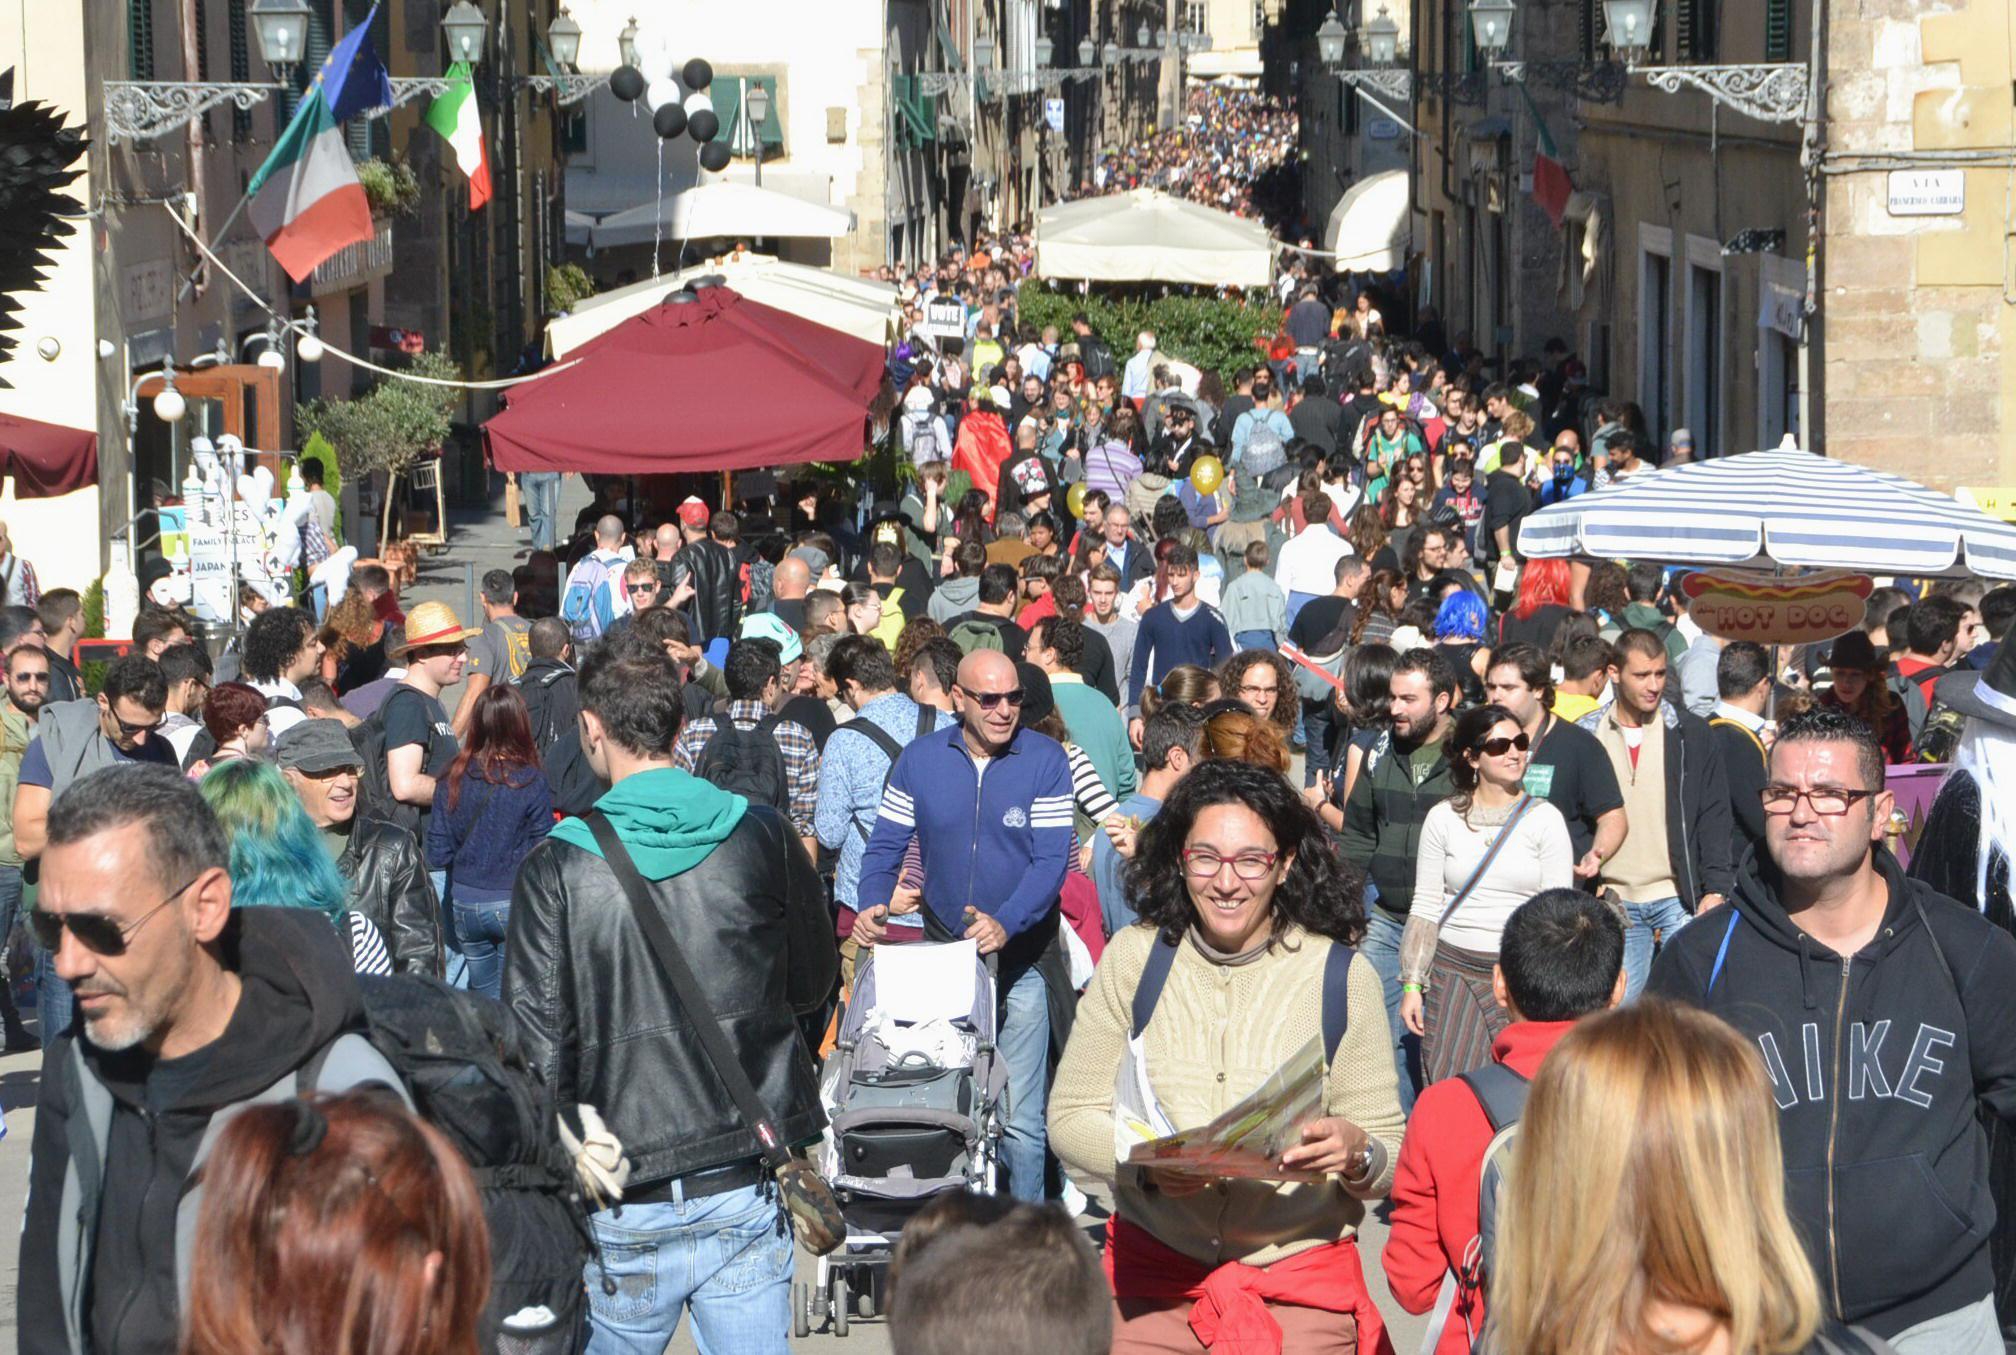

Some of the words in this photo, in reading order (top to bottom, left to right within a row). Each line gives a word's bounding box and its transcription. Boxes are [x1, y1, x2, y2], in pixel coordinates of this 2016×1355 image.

[930, 304, 959, 322] VOTE
[192, 538, 221, 546] FAMILY
[1717, 606, 1775, 630] HOT
[1787, 605, 1849, 630] DOG
